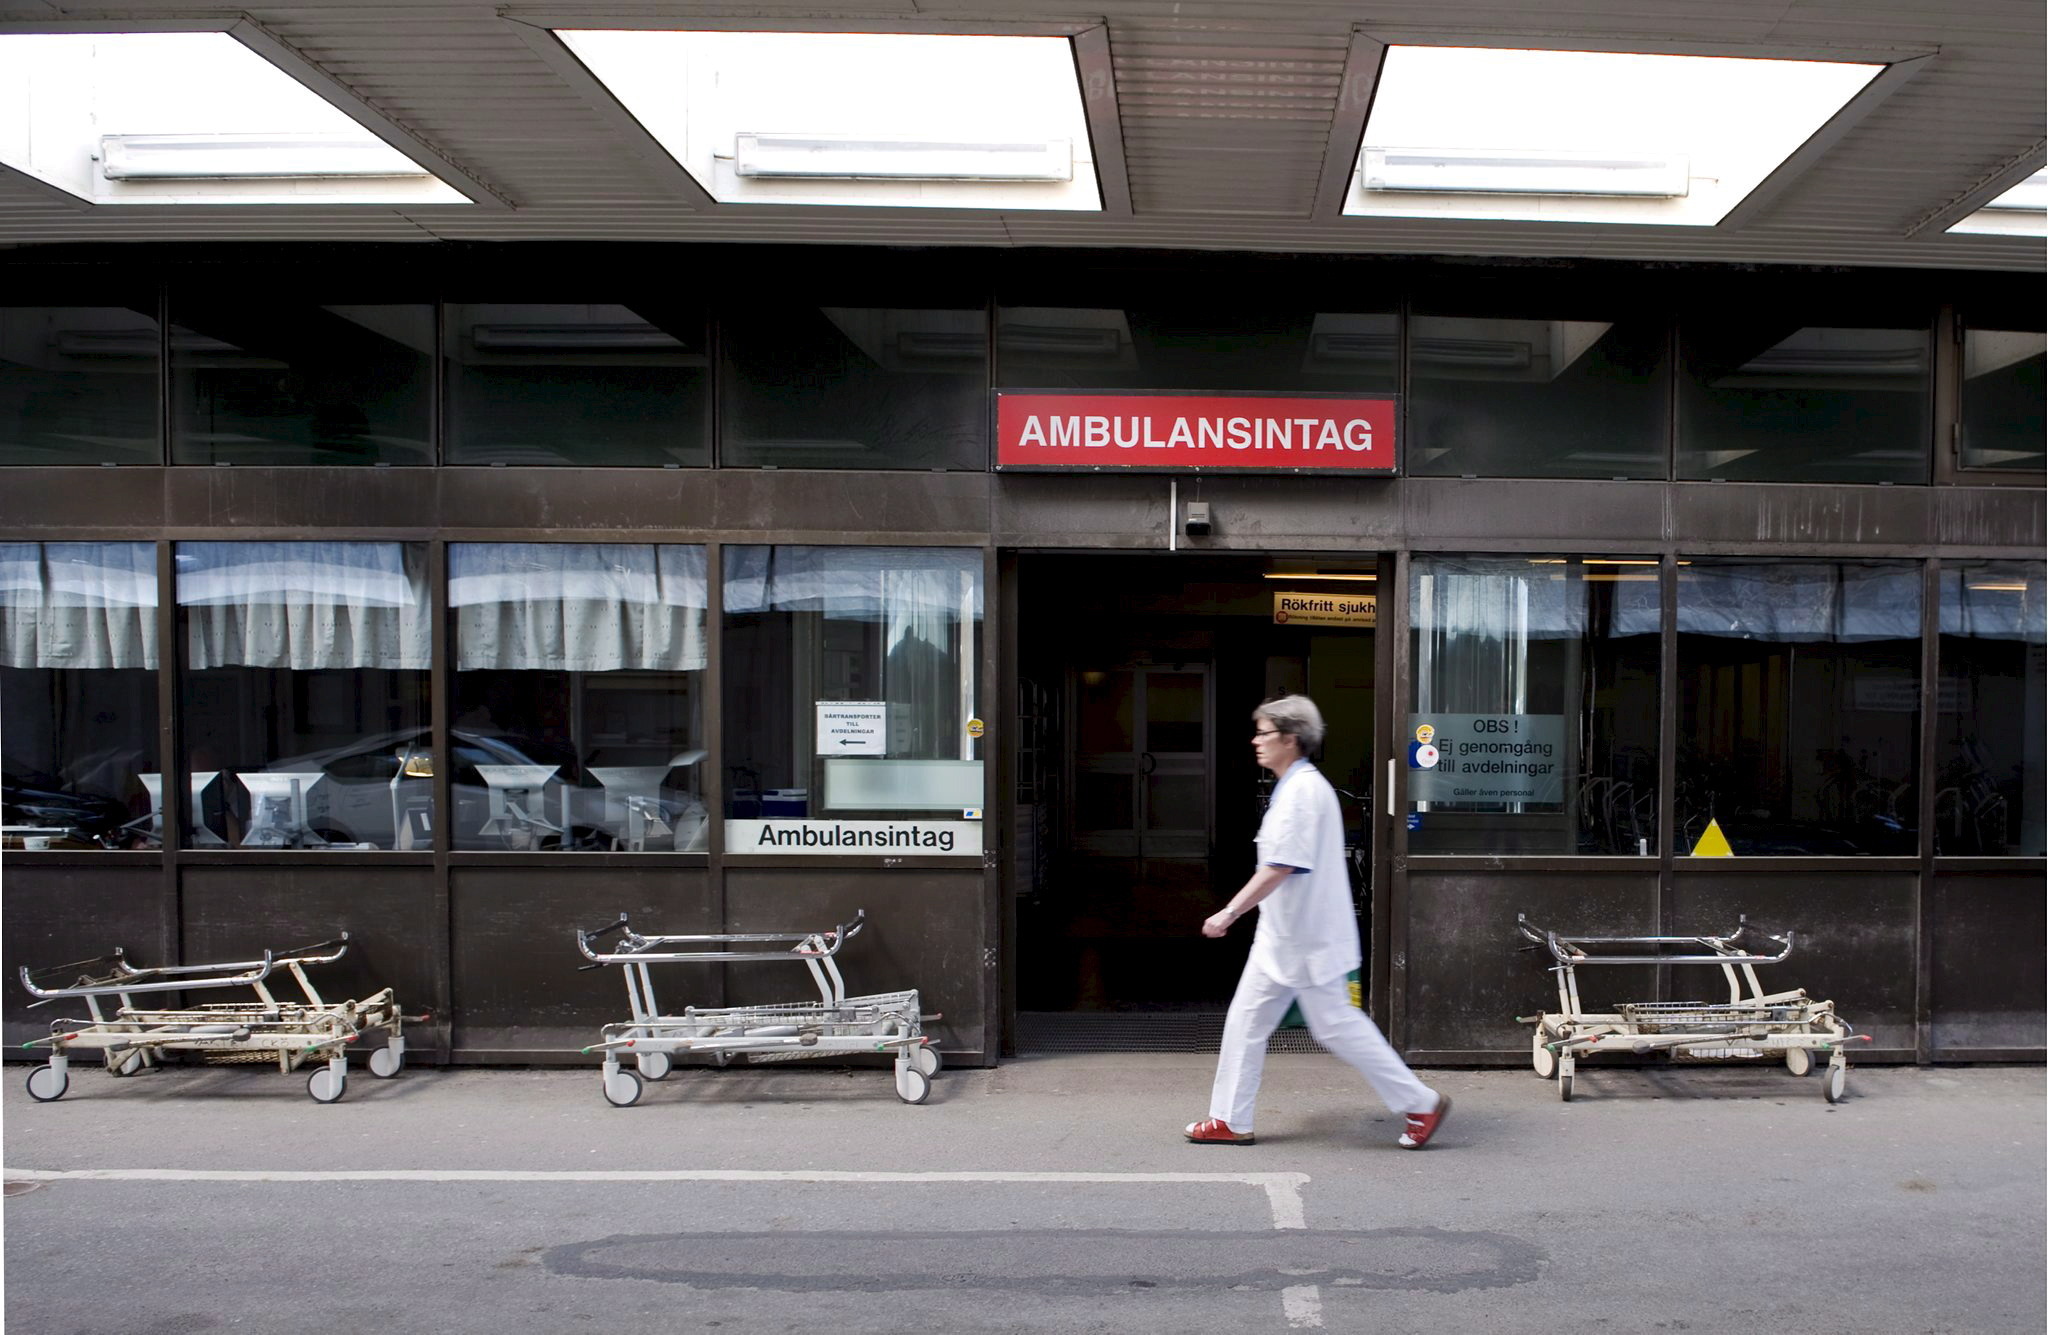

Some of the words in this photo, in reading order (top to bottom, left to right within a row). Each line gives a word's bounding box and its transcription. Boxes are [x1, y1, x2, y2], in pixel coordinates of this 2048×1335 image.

[1018, 415, 1373, 451] AMBULANSINTAG
[1282, 599, 1334, 612] Rökfritt
[1473, 719, 1509, 734] OBS
[1438, 738, 1453, 756] Ej
[1460, 740, 1552, 757] genomgång
[1438, 758, 1455, 772] till
[1462, 760, 1554, 778] avdelningar
[1453, 787, 1477, 796] Gäller
[1500, 788, 1535, 798] personal
[758, 823, 955, 851] Ambulansintag
